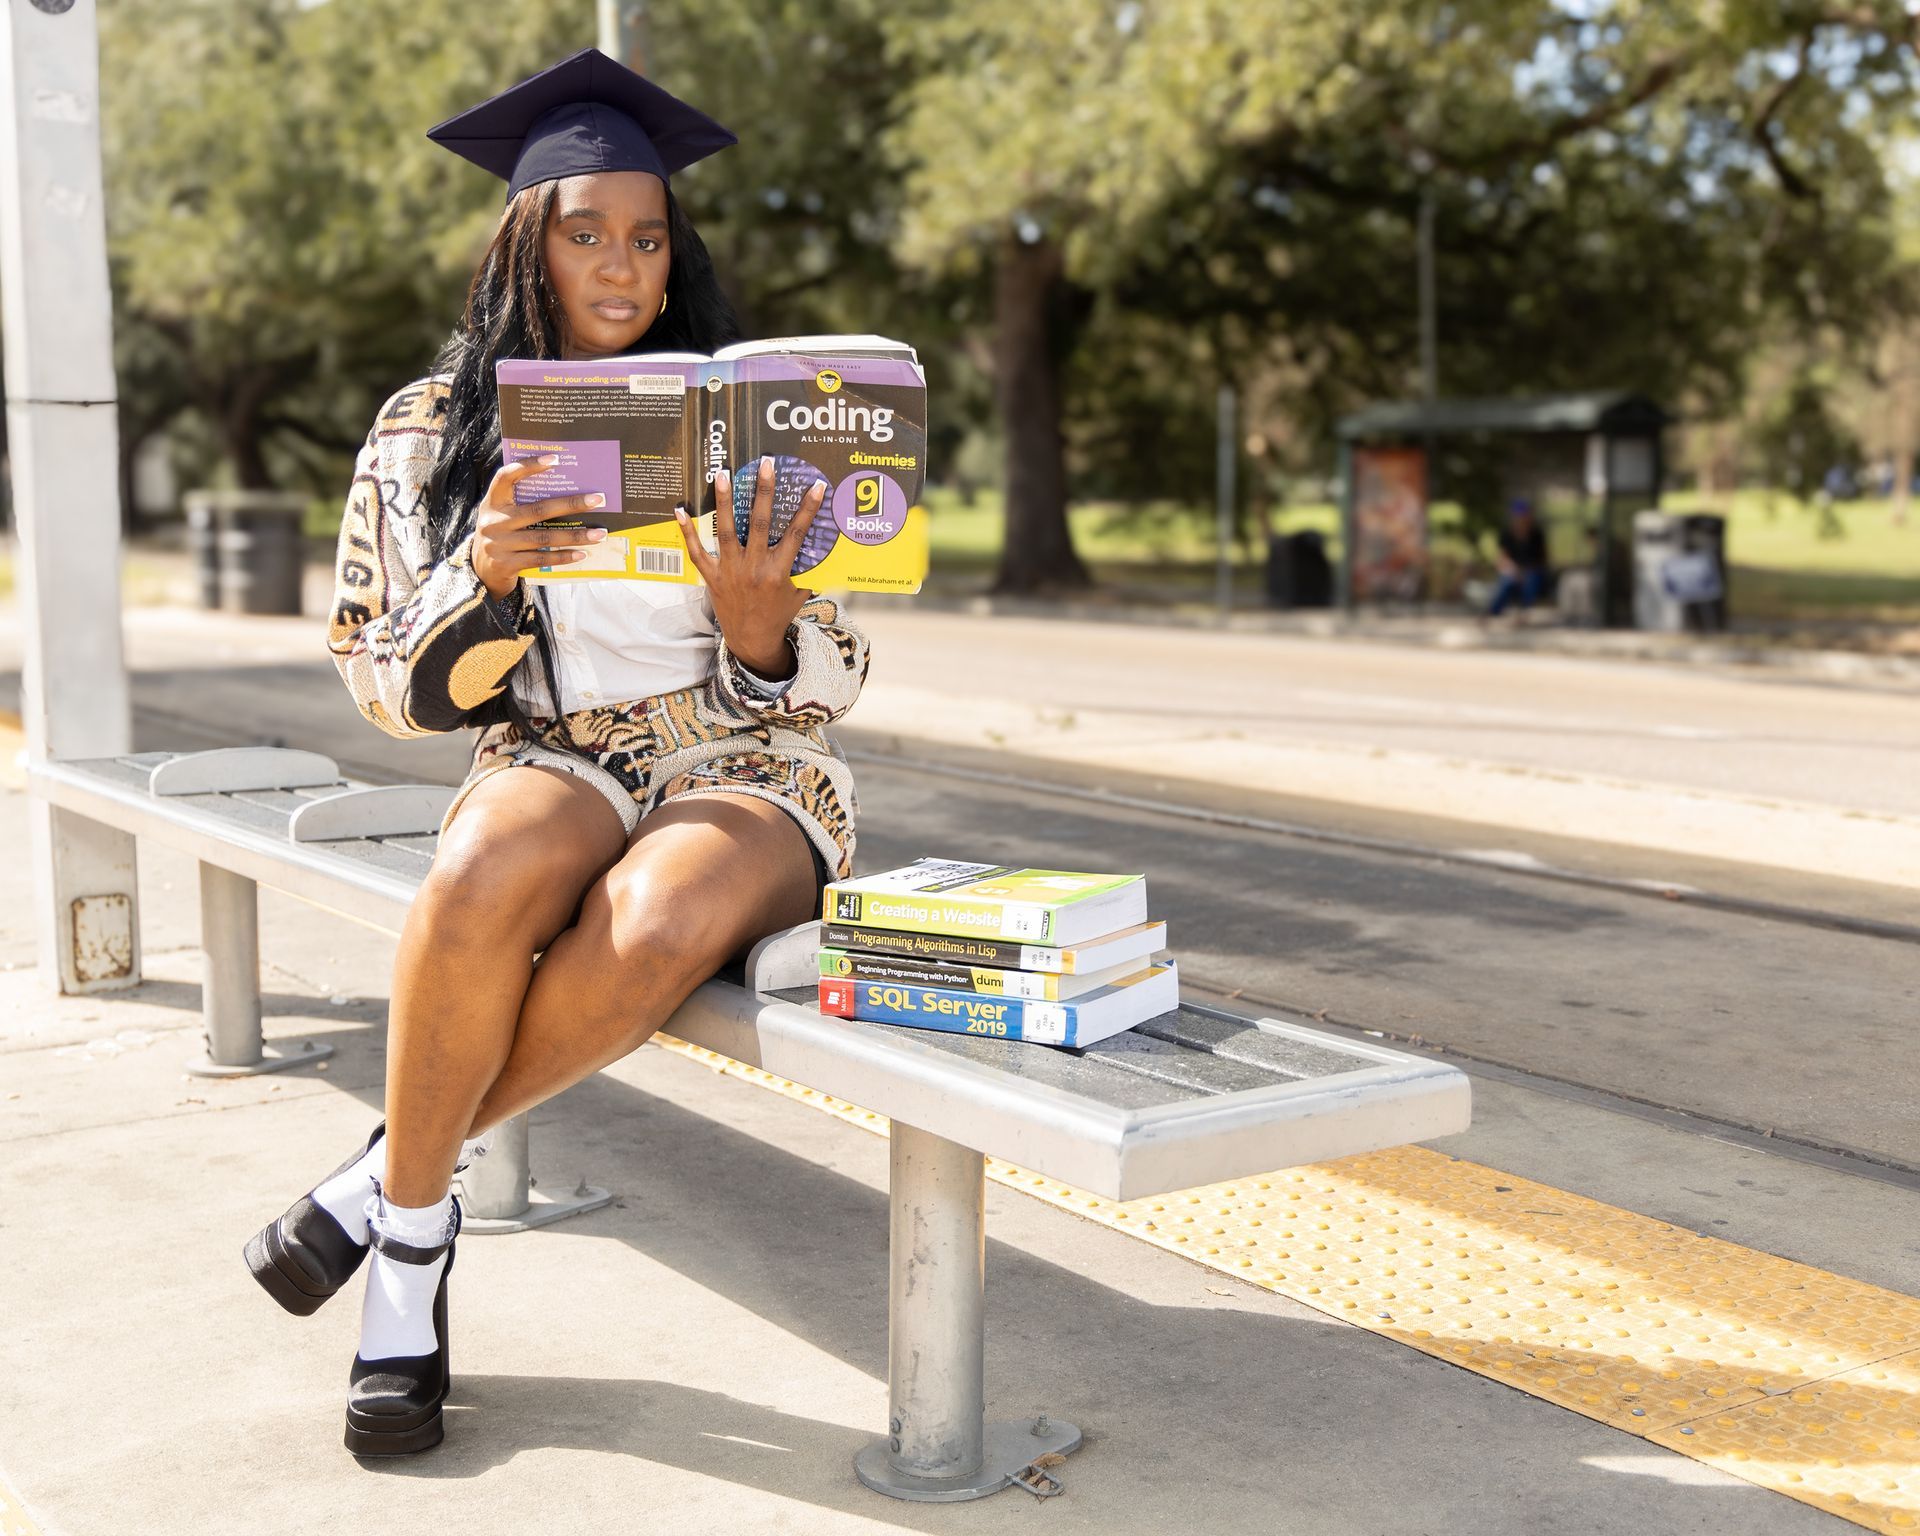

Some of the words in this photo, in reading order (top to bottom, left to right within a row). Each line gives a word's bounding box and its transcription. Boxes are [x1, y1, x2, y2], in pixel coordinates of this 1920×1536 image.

[584, 376, 609, 384] coding
[766, 398, 894, 442] Coding
[801, 436, 858, 444] ALL-IN-ONE
[705, 420, 726, 484] Coding
[849, 451, 916, 467] dummies
[856, 478, 878, 512] 9
[846, 517, 893, 532] Books
[854, 531, 863, 539] in
[864, 531, 884, 540] one!
[847, 576, 866, 584] Nikhil
[868, 576, 896, 584] Abraham
[870, 901, 929, 922] Creating
[932, 909, 940, 921] a
[943, 907, 1000, 928] Website
[829, 932, 848, 941] Domkin
[853, 931, 913, 951] Programming
[915, 940, 965, 956] Algorithms
[966, 942, 976, 955] in
[978, 944, 997, 960] Lisp
[857, 964, 887, 976] Beginning
[887, 968, 928, 980] Programming
[929, 972, 943, 980] with
[868, 986, 916, 1011] SQL
[922, 993, 1007, 1020] Server
[966, 1019, 1007, 1036] 2019
